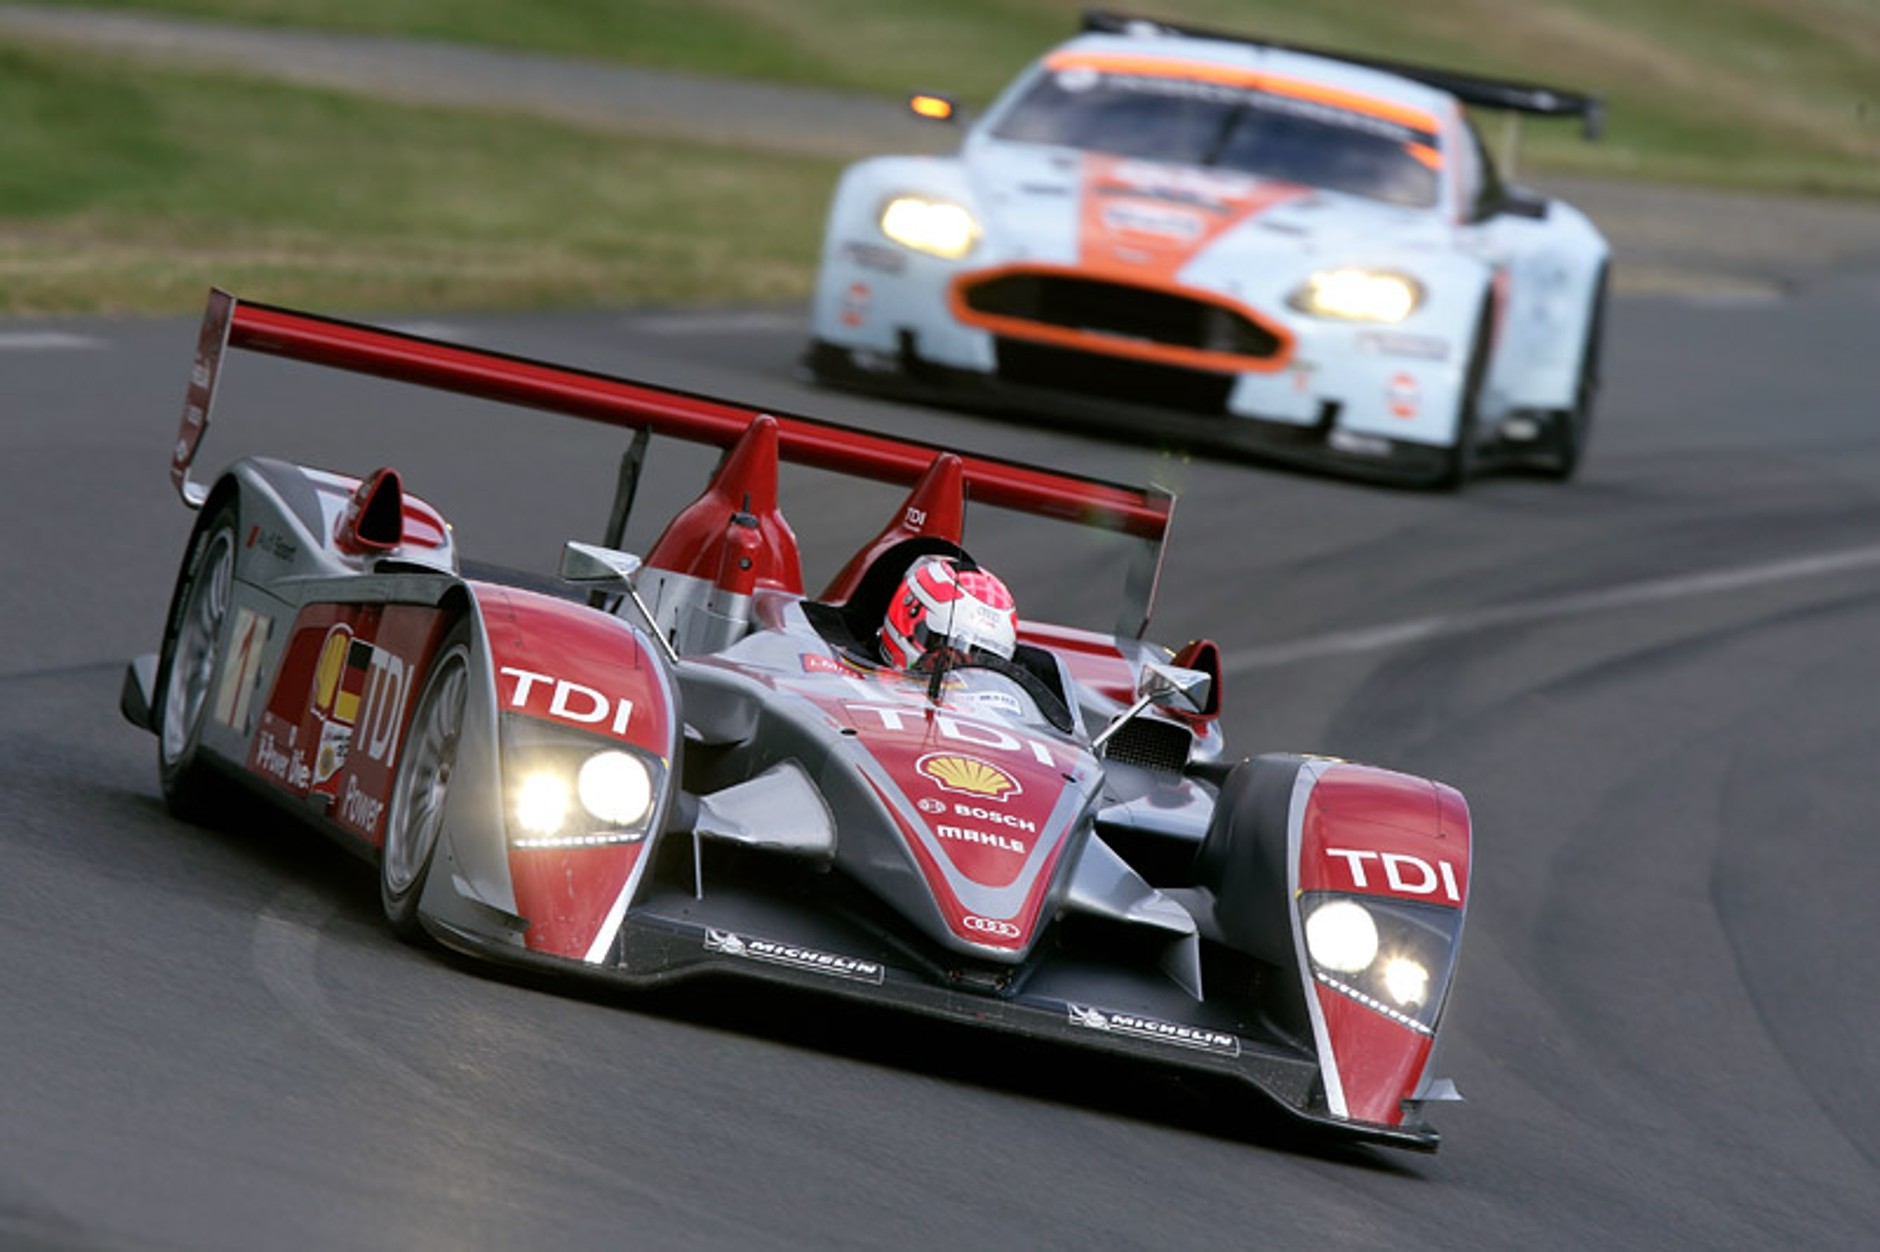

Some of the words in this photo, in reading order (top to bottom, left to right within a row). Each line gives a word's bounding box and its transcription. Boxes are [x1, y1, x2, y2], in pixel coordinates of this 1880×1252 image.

[357, 646, 415, 768] TDI
[500, 667, 634, 735] TDI
[845, 704, 1055, 768] TDI
[937, 825, 1027, 854] MAHLE
[954, 803, 1036, 833] BOSCH
[1325, 848, 1461, 902] TDI
[750, 941, 877, 974] MICHELIN
[1111, 1014, 1232, 1046] MICHELIN
